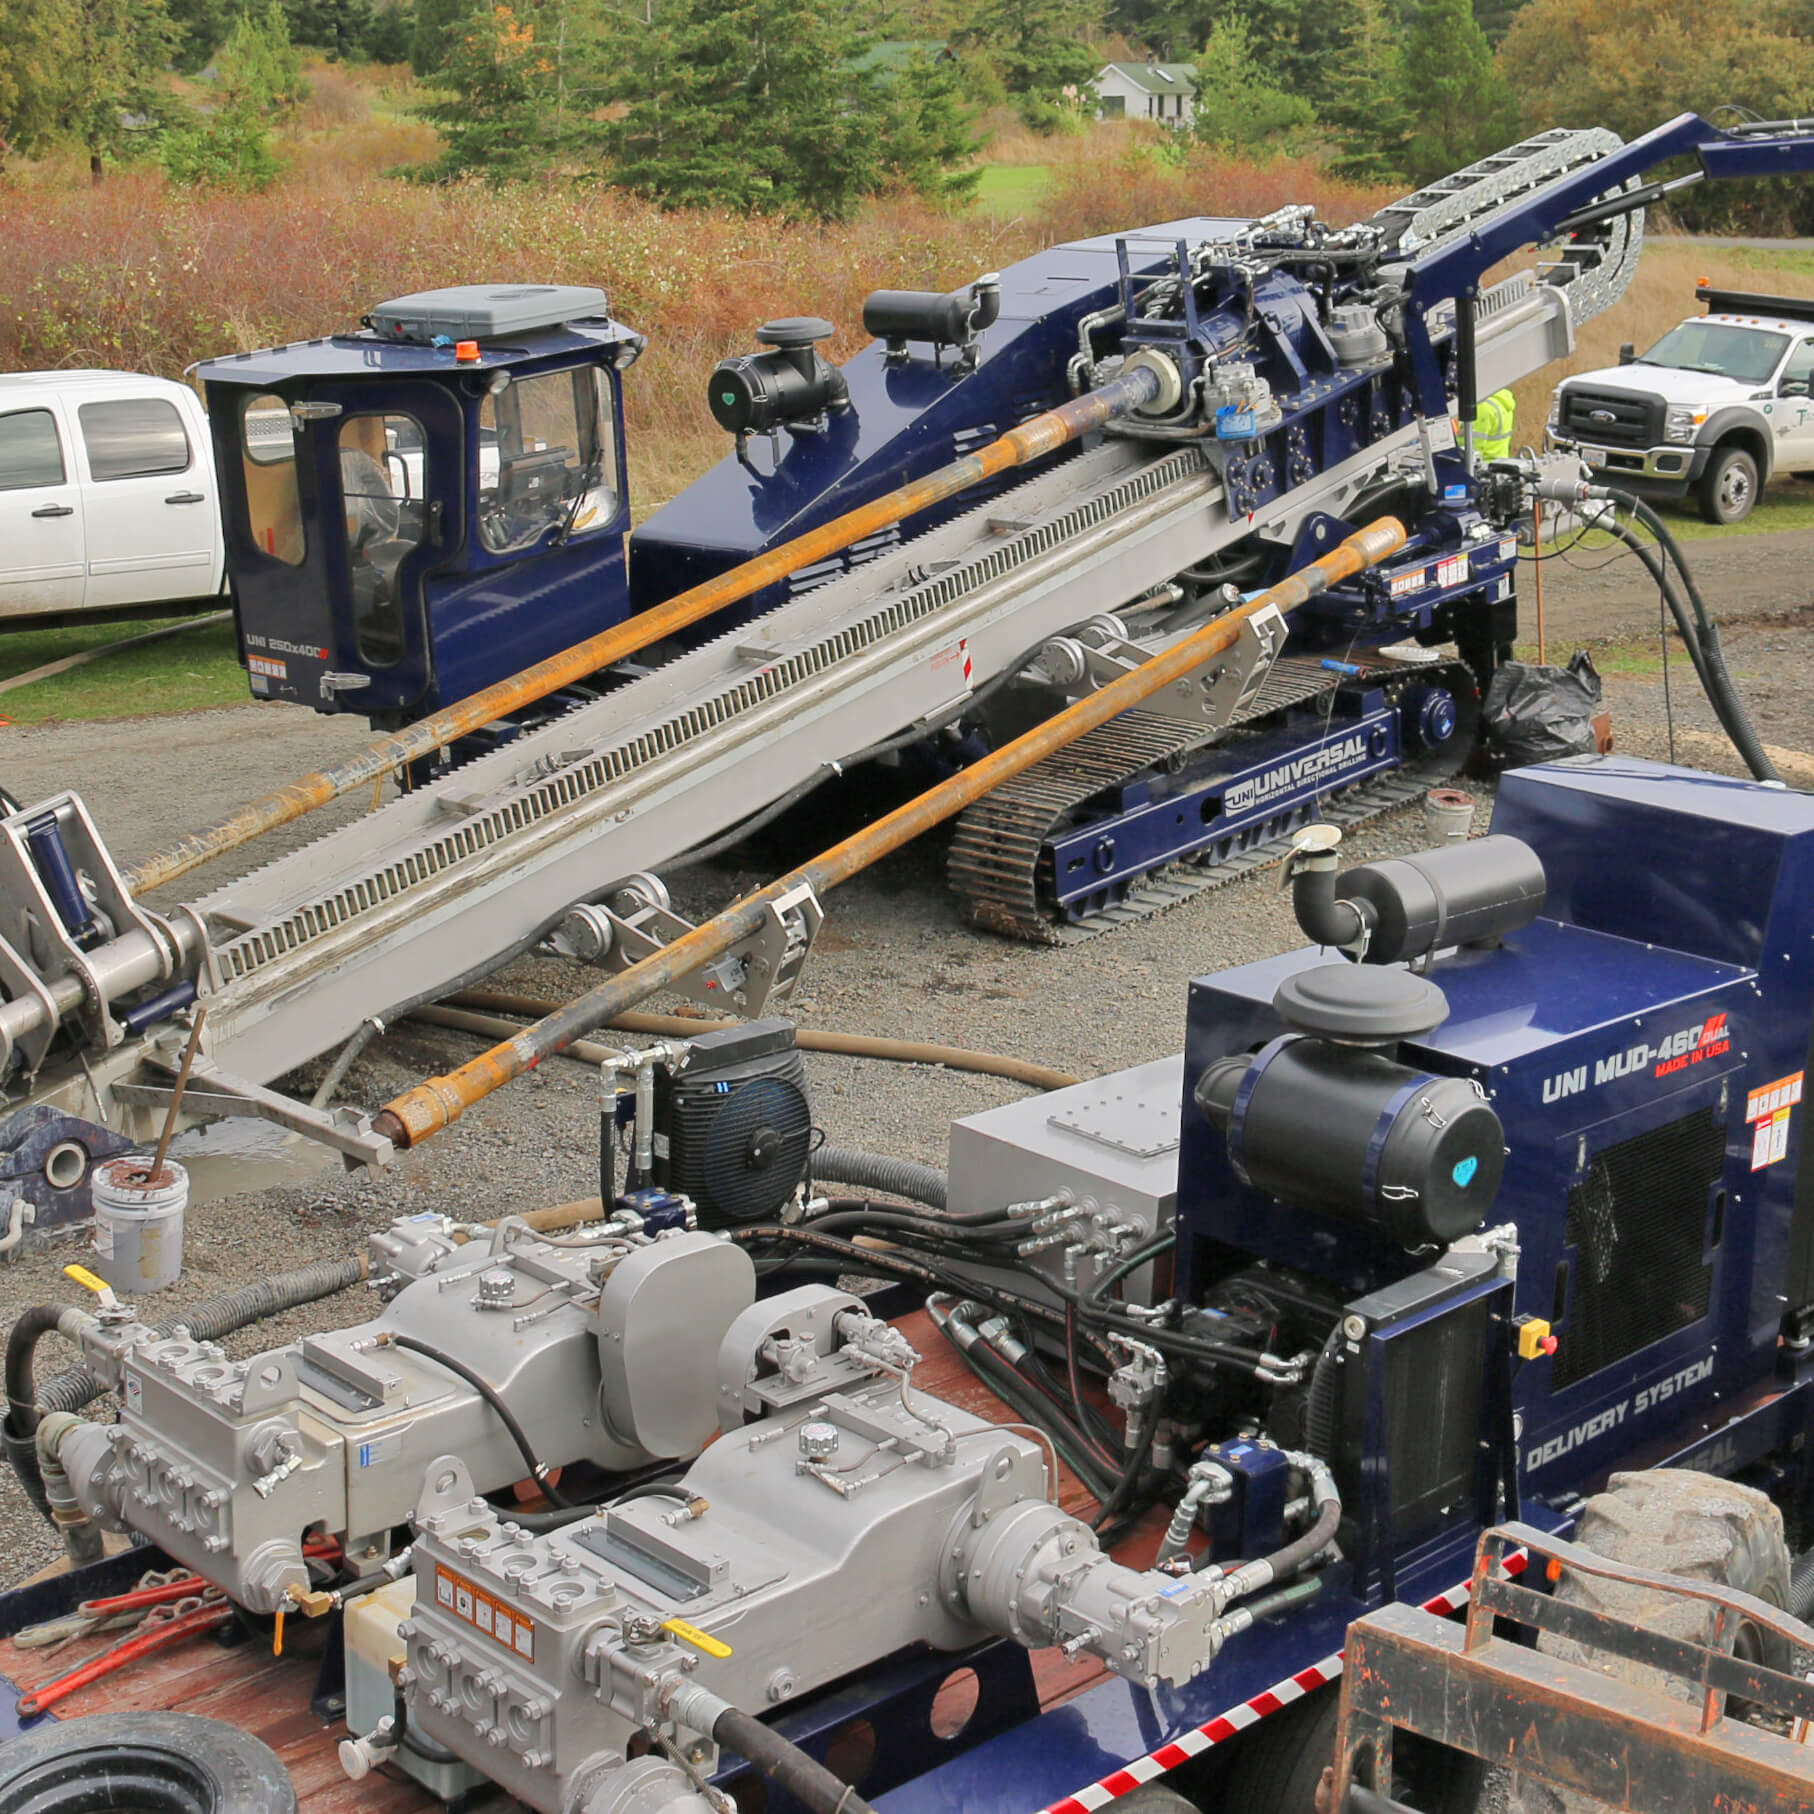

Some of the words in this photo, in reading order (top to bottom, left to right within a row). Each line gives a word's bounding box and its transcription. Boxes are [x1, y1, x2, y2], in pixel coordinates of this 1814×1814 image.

[1254, 735, 1367, 796] UNIVERSAL
[1542, 1066, 1588, 1104] UNI
[1594, 1024, 1703, 1086] MUD-460
[1654, 1054, 1689, 1078] MADE
[1691, 1049, 1703, 1064] IN
[1706, 1039, 1731, 1058] USA
[1702, 1025, 1730, 1044] DUAL
[1526, 1399, 1629, 1473] DELIVERY
[1633, 1355, 1714, 1415] SYSTEM
